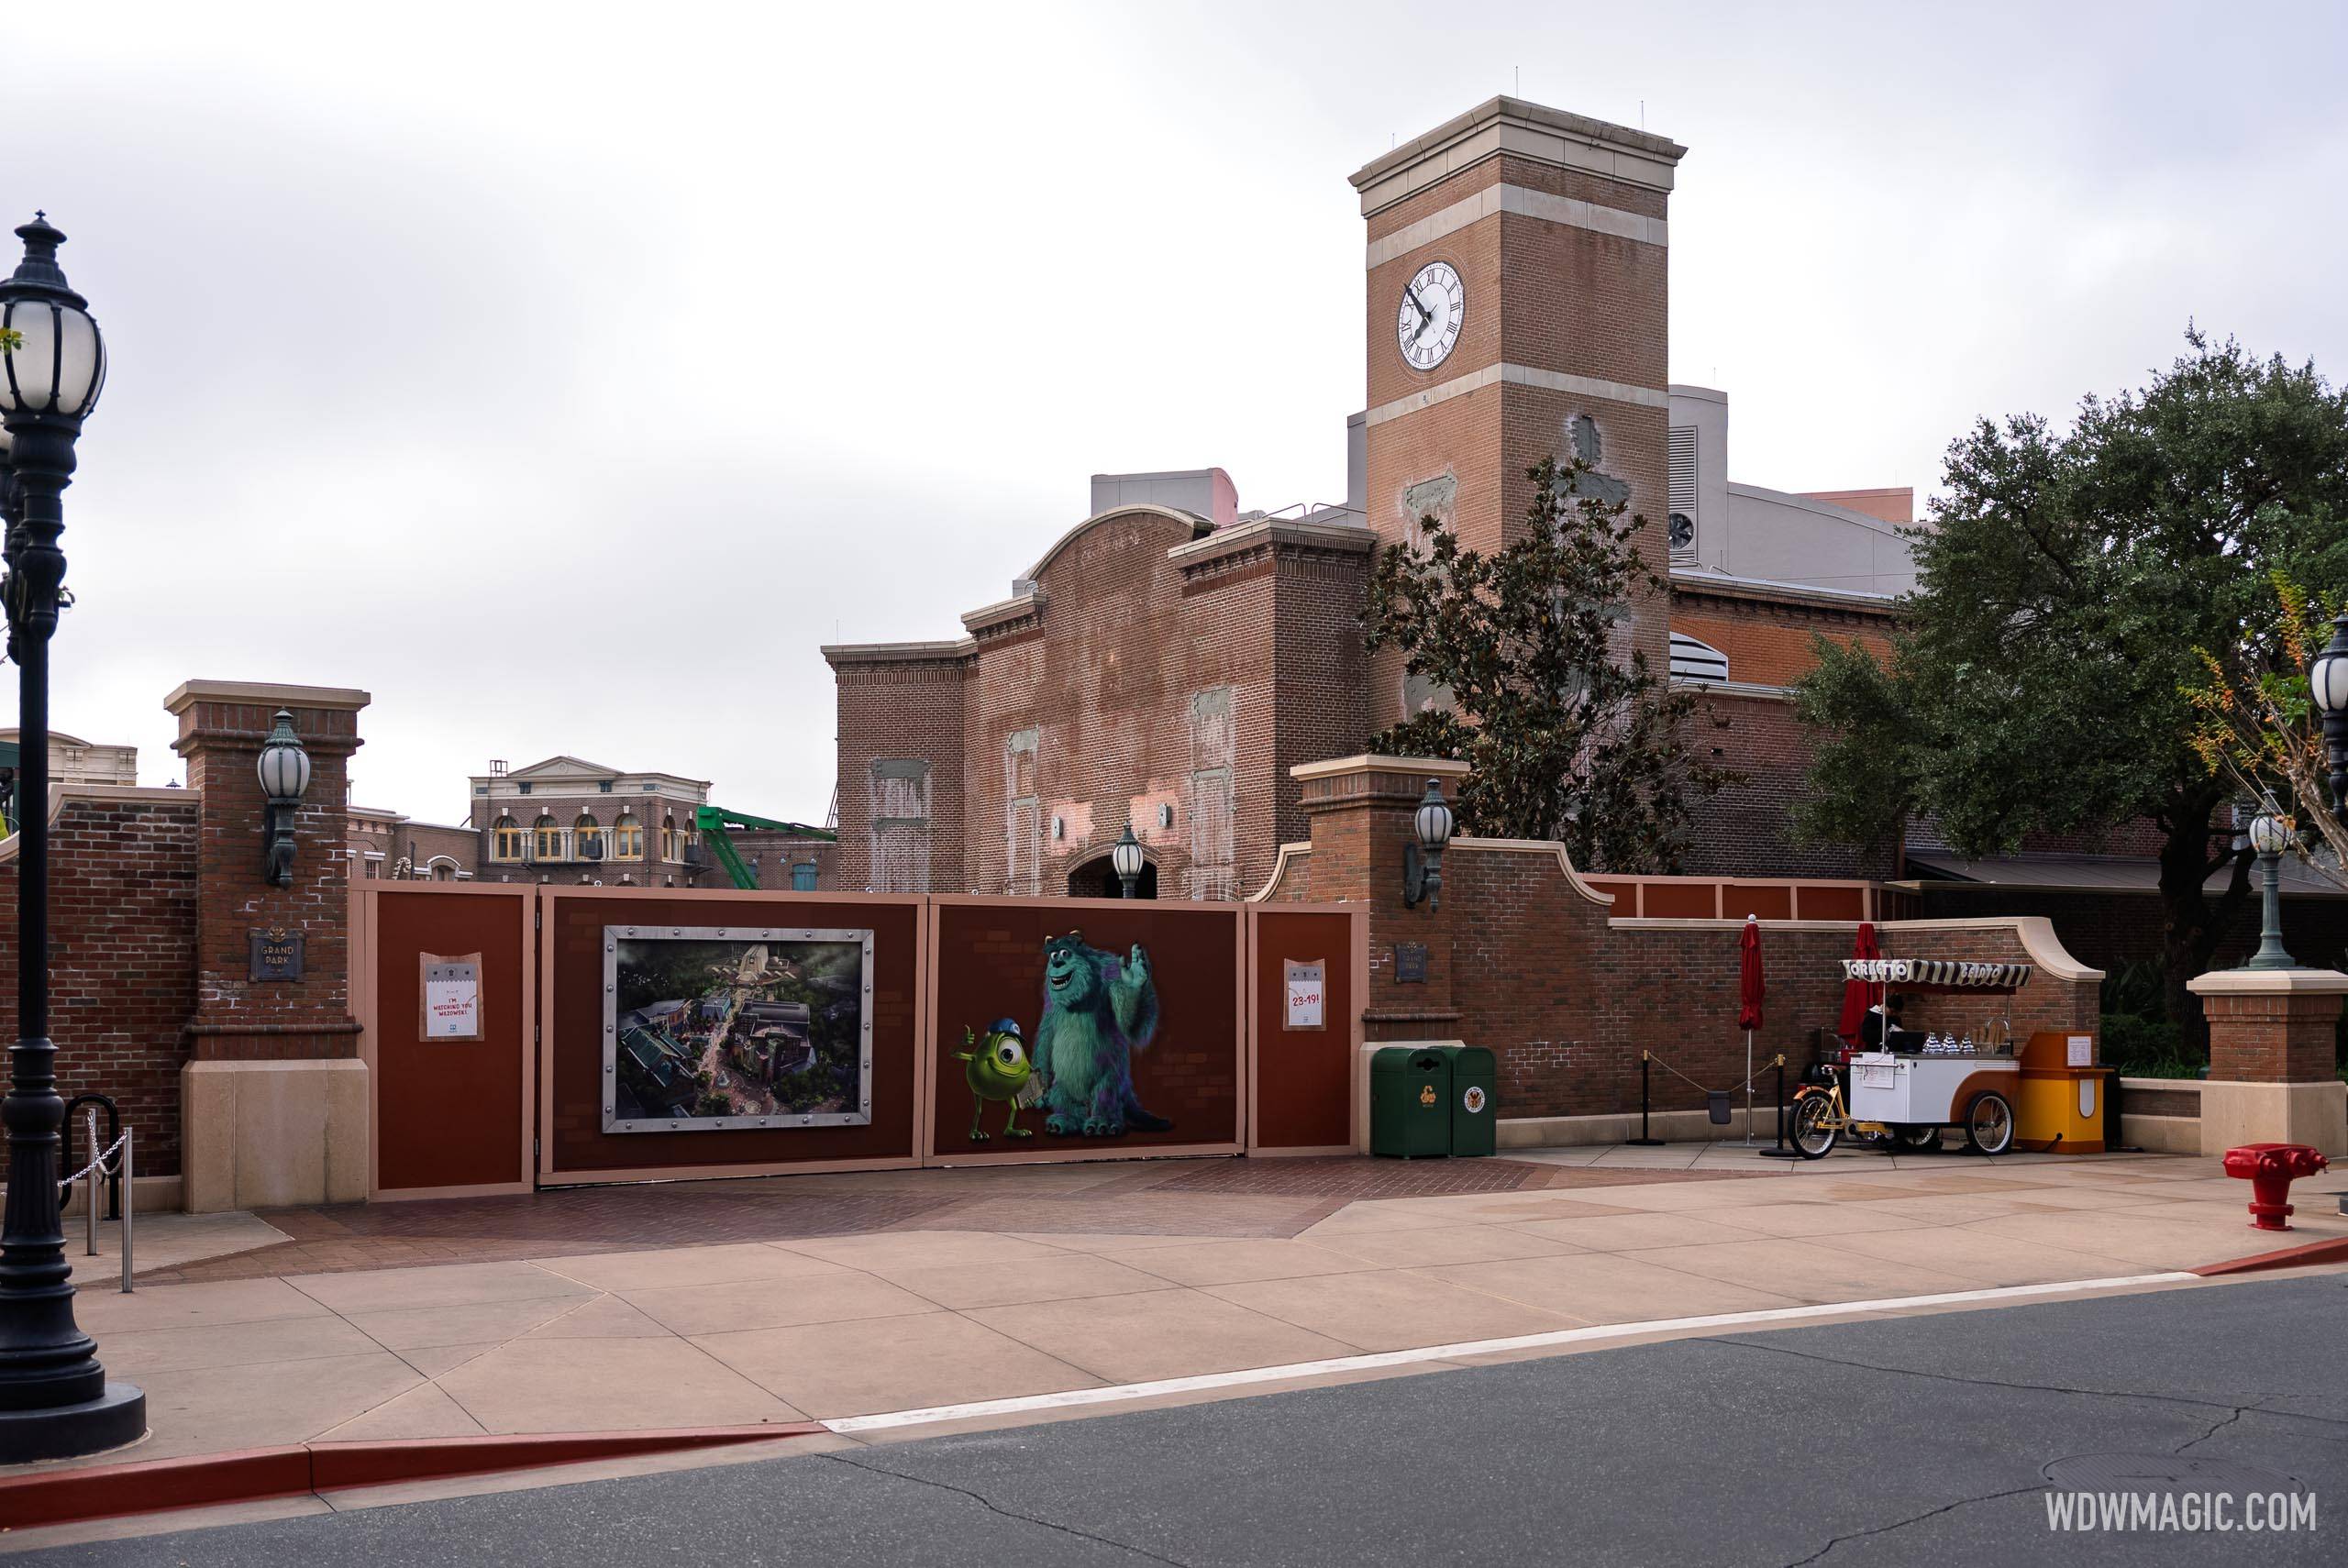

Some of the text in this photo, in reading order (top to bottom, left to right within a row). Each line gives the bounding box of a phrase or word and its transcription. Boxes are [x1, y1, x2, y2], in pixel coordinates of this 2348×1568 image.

[261, 945, 294, 955] GRAND
[265, 955, 289, 965] PARK
[1292, 994, 1320, 1007] 23-19!
